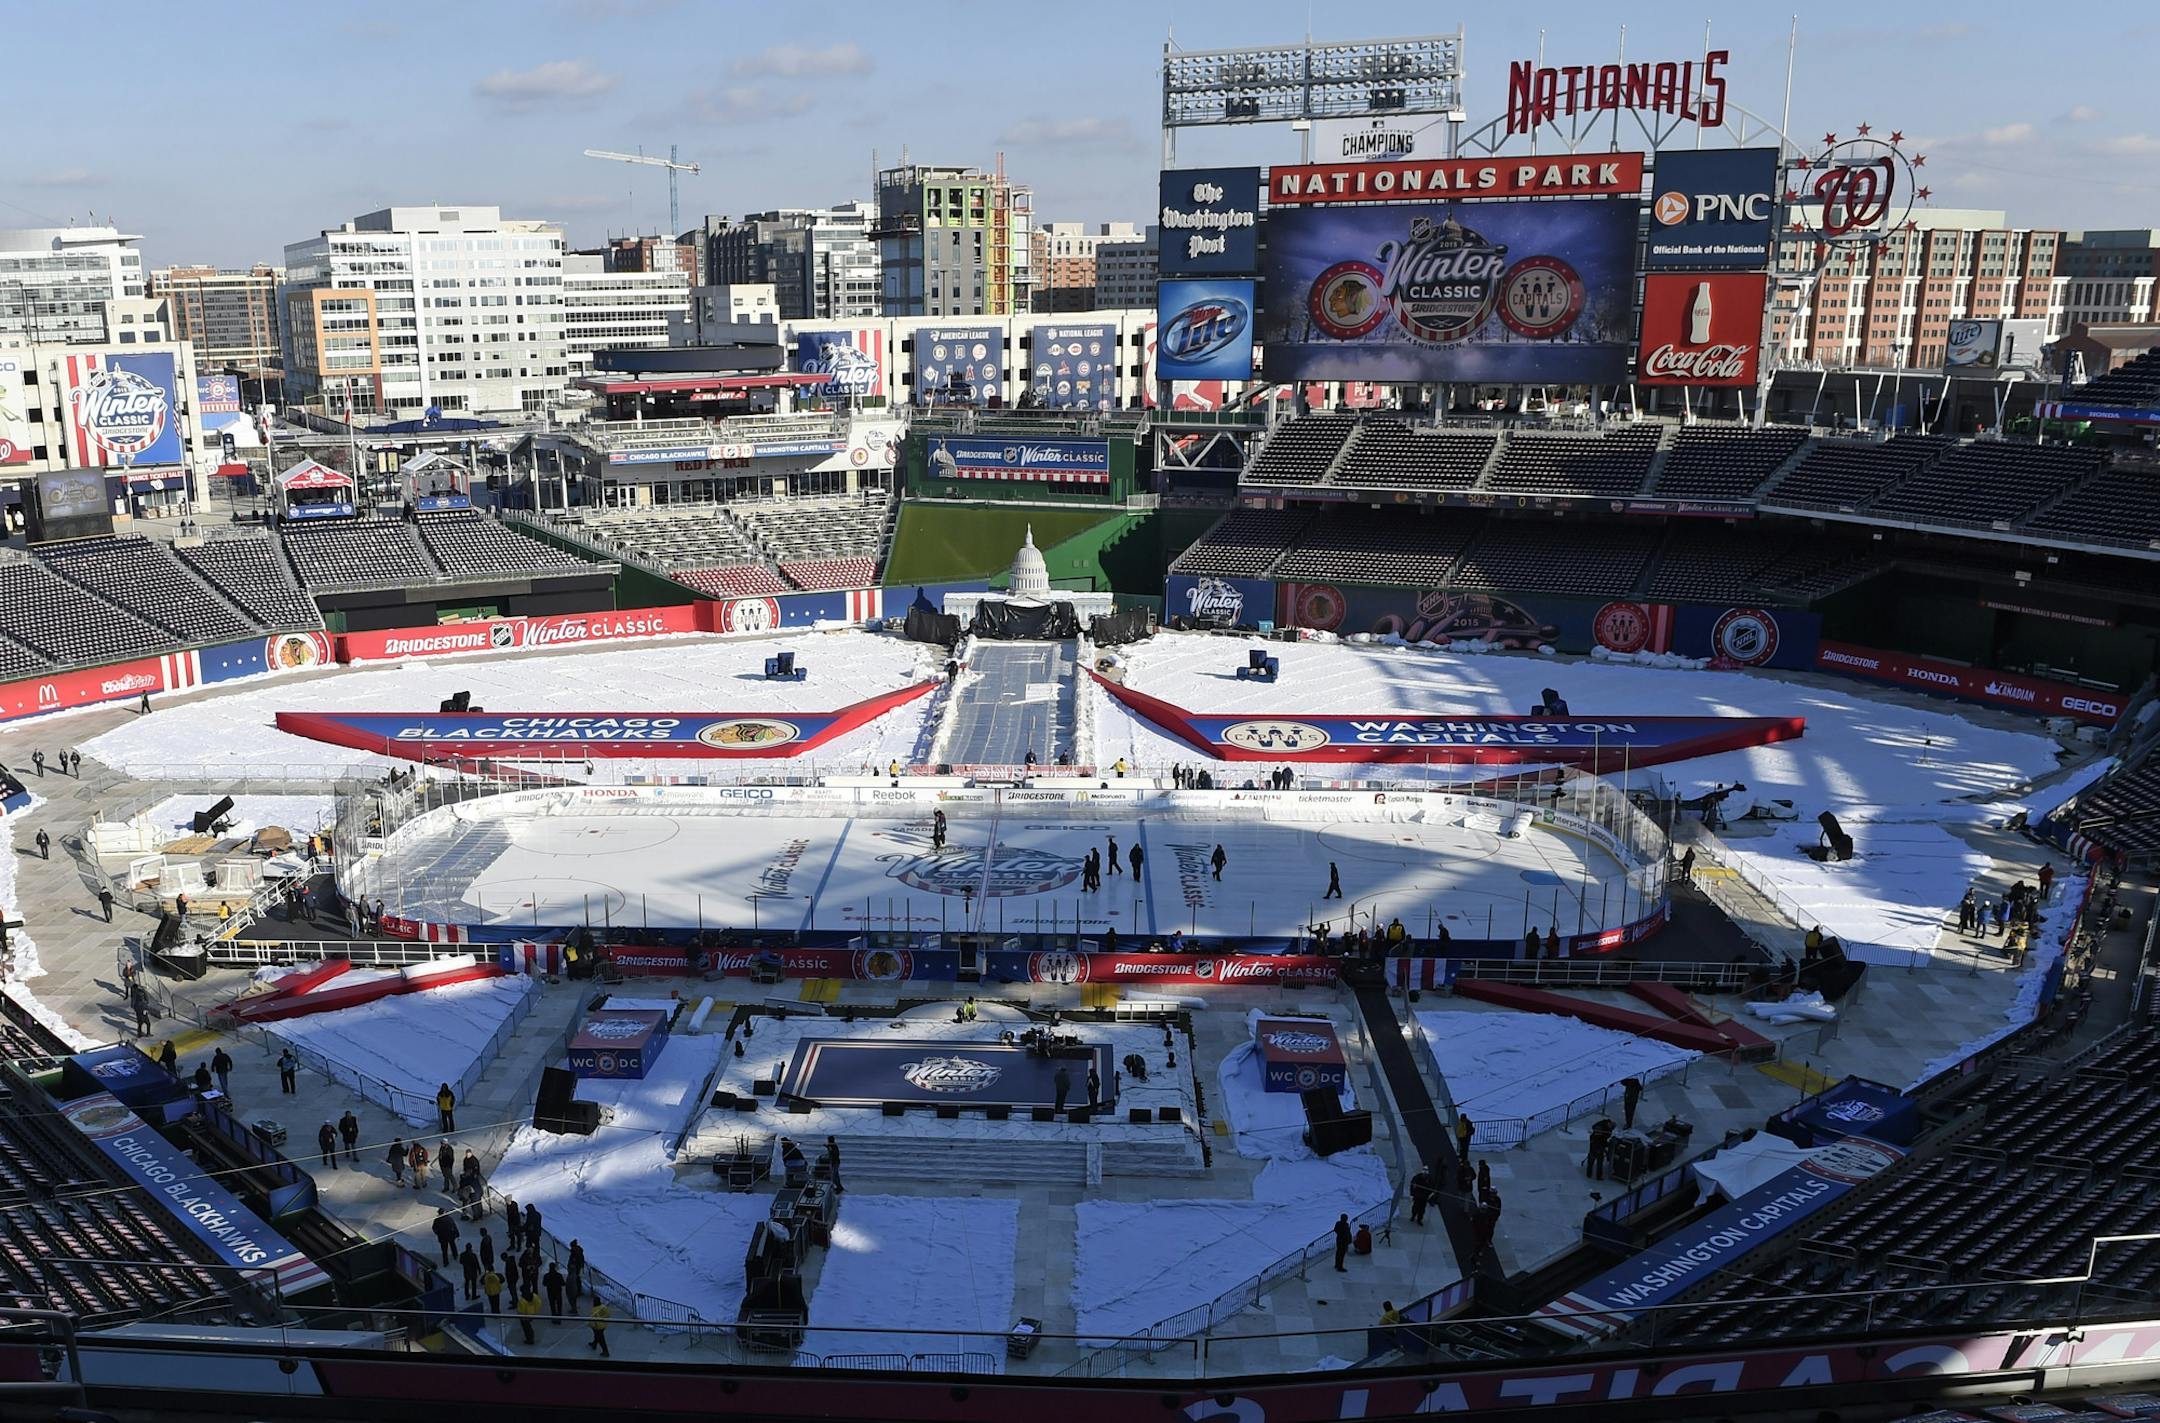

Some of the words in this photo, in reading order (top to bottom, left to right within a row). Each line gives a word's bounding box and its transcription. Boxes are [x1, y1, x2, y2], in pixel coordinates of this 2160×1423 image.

[1507, 50, 1729, 135] NATIONALS
[1342, 133, 1413, 156] CHAMPIONS
[1281, 167, 1497, 195] NATIONALS
[1517, 163, 1621, 188] PARK
[1193, 183, 1224, 204] The
[1694, 192, 1770, 222] PNC
[1162, 206, 1254, 232] Washington
[1189, 235, 1226, 259] Post
[1653, 245, 1681, 255] Official
[1682, 245, 1700, 254] Bank
[1701, 244, 1712, 254] of
[1713, 245, 1726, 254] the
[1727, 244, 1765, 254] Nationals
[1376, 240, 1508, 298] Winter
[1410, 285, 1481, 299] CLASSIC
[1512, 292, 1564, 305] CAPITALS
[1411, 303, 1478, 314] BRIDGESTONE
[941, 332, 968, 340] AMERICAN
[969, 331, 990, 339] LEAGUE
[1059, 330, 1083, 338] NATIONAL
[1084, 329, 1104, 337] LEAGUE
[1646, 343, 1753, 378] Coca-Cola
[69, 387, 168, 426] Winter
[100, 414, 150, 425] CLASSIC
[629, 453, 657, 461] CHICAGO
[659, 450, 706, 459] BLACKHAWKS
[756, 447, 799, 455] WASHINGTON
[800, 444, 830, 452] CAPITALS
[956, 450, 1002, 460] BRIDGESTONE
[1019, 445, 1063, 466] Winter
[1063, 452, 1104, 463] CLASSIC
[1186, 586, 1243, 614] Winter
[1423, 592, 1446, 612] NHL
[1201, 608, 1232, 616] CLASSIC
[1453, 618, 1480, 628] 2015
[385, 632, 486, 655] BRIDGESTONE
[515, 619, 589, 647] Winter
[592, 618, 664, 638] CLASSIC
[1735, 630, 1756, 647] NHL
[1822, 650, 1880, 670] BRIDGESTONE
[1907, 667, 1960, 686] HONDA
[1997, 683, 2036, 702] CANADIAN
[2061, 696, 2117, 718] GEICO
[502, 717, 681, 728] CHICAGO
[1350, 721, 1638, 734] WASHINGTON
[397, 728, 673, 740] BLACKHAWKS
[1356, 733, 1561, 744] CAPITALS
[583, 788, 639, 797] HONDA
[720, 788, 773, 799] GEICO
[872, 789, 916, 800] Reebok
[1008, 791, 1066, 801] BRIDGESTONE
[1299, 795, 1353, 804] ticketmaster
[875, 851, 1085, 878] Winter
[932, 872, 1045, 880] CLASSIC
[781, 953, 829, 969] LASSIC
[1114, 962, 1192, 975] BRIDGESTONE
[1216, 959, 1274, 982] Winter
[1276, 963, 1337, 978] CLASSIC
[572, 1057, 595, 1068] WC
[619, 1058, 639, 1068] DC
[899, 1062, 1002, 1081] Winter
[1270, 1071, 1294, 1082] WC
[1320, 1073, 1341, 1083] DC
[113, 1137, 176, 1184] CHICAGO
[164, 1182, 267, 1264] BLACKHAWKS
[1608, 1226, 1749, 1308] WASHINGTON
[1739, 1179, 1831, 1231] CAPITALS
